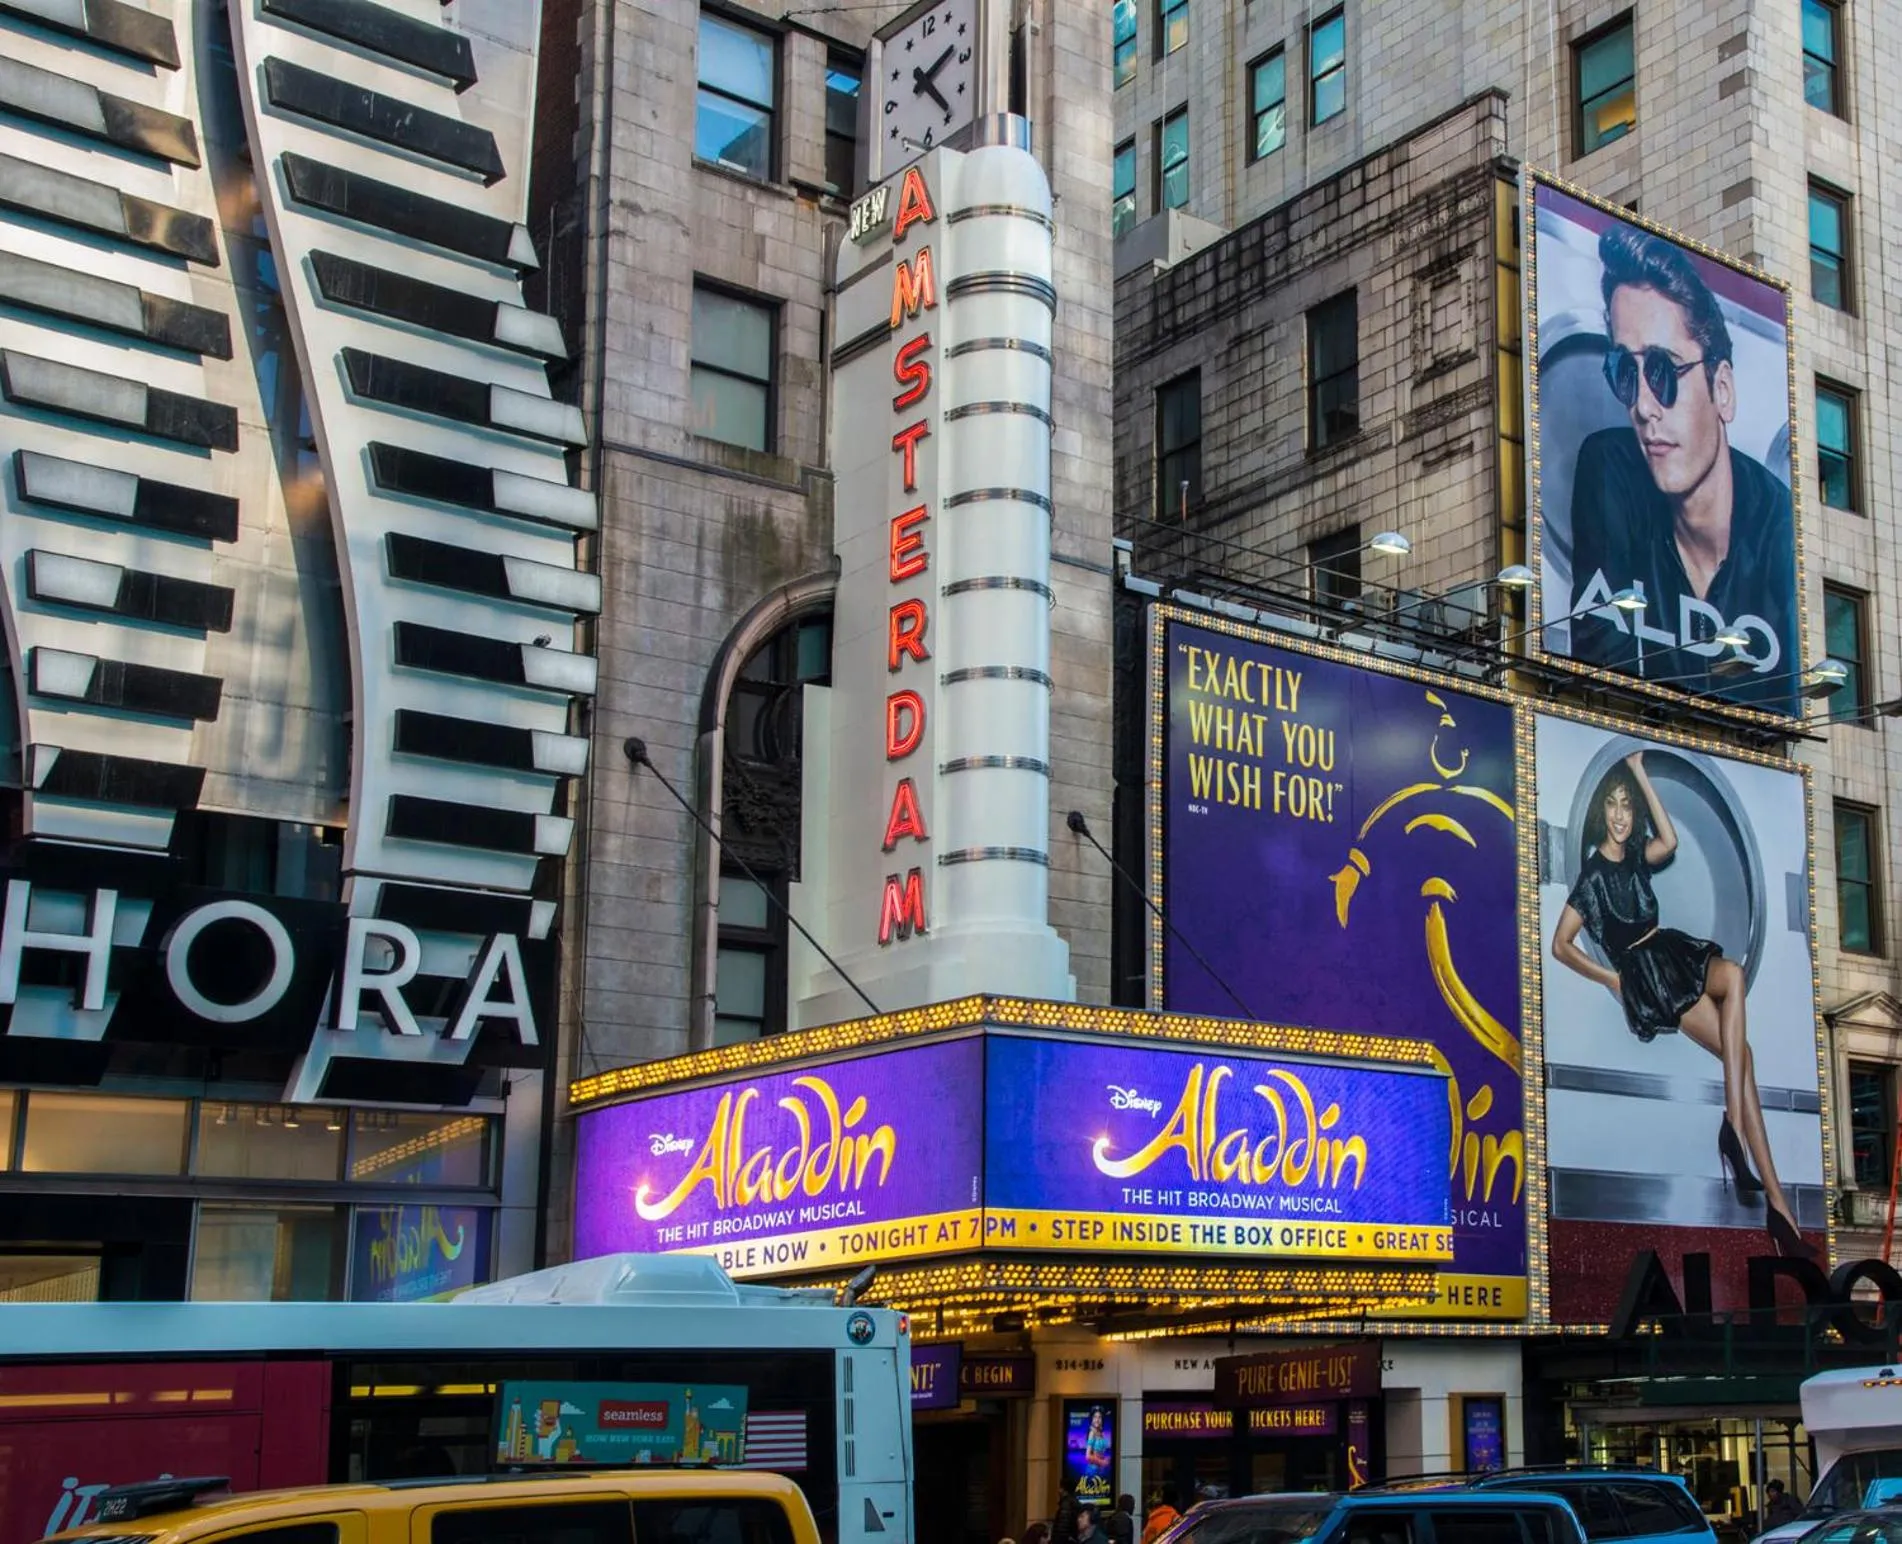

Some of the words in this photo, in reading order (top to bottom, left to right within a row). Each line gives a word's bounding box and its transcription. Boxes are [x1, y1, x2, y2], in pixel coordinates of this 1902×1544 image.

[851, 187, 889, 239] NEW
[878, 166, 937, 946] AMSTERDAM
[1571, 568, 1780, 673] ALDO
[1188, 700, 1268, 757] WHAT
[1281, 720, 1334, 771] YOU
[1188, 753, 1261, 810] WISH
[0, 879, 540, 1047] HORA
[635, 1076, 896, 1221] Aladdin
[1092, 1063, 1368, 1190] Aladdin
[657, 1227, 684, 1244] THE
[687, 1222, 709, 1238] HIT
[713, 1210, 795, 1237] BROADWAY
[799, 1200, 866, 1223] MUSICAL
[1122, 1188, 1153, 1206] THE
[1158, 1189, 1183, 1207] HIT
[1188, 1192, 1275, 1211] BROADWAY
[1280, 1196, 1343, 1214] MUSICAL
[763, 1240, 809, 1264] NOW
[839, 1224, 929, 1255] TONIGHT
[936, 1220, 961, 1243] AT
[1052, 1220, 1104, 1240] STEP
[1113, 1222, 1181, 1244] INSIDE
[1190, 1224, 1226, 1244] THE
[1234, 1226, 1273, 1246] BOX
[1281, 1227, 1347, 1248] OFFICE
[1373, 1231, 1429, 1251] GREAT
[1448, 1286, 1503, 1307] HERE
[975, 1365, 1013, 1384] BEGIN
[1174, 1359, 1198, 1370] NEW
[603, 1409, 664, 1421] seamless
[1145, 1411, 1201, 1430] PURCHASE
[1205, 1410, 1233, 1428] YOUR
[1250, 1410, 1291, 1428] TICKETS
[1295, 1409, 1326, 1427] HERE!
